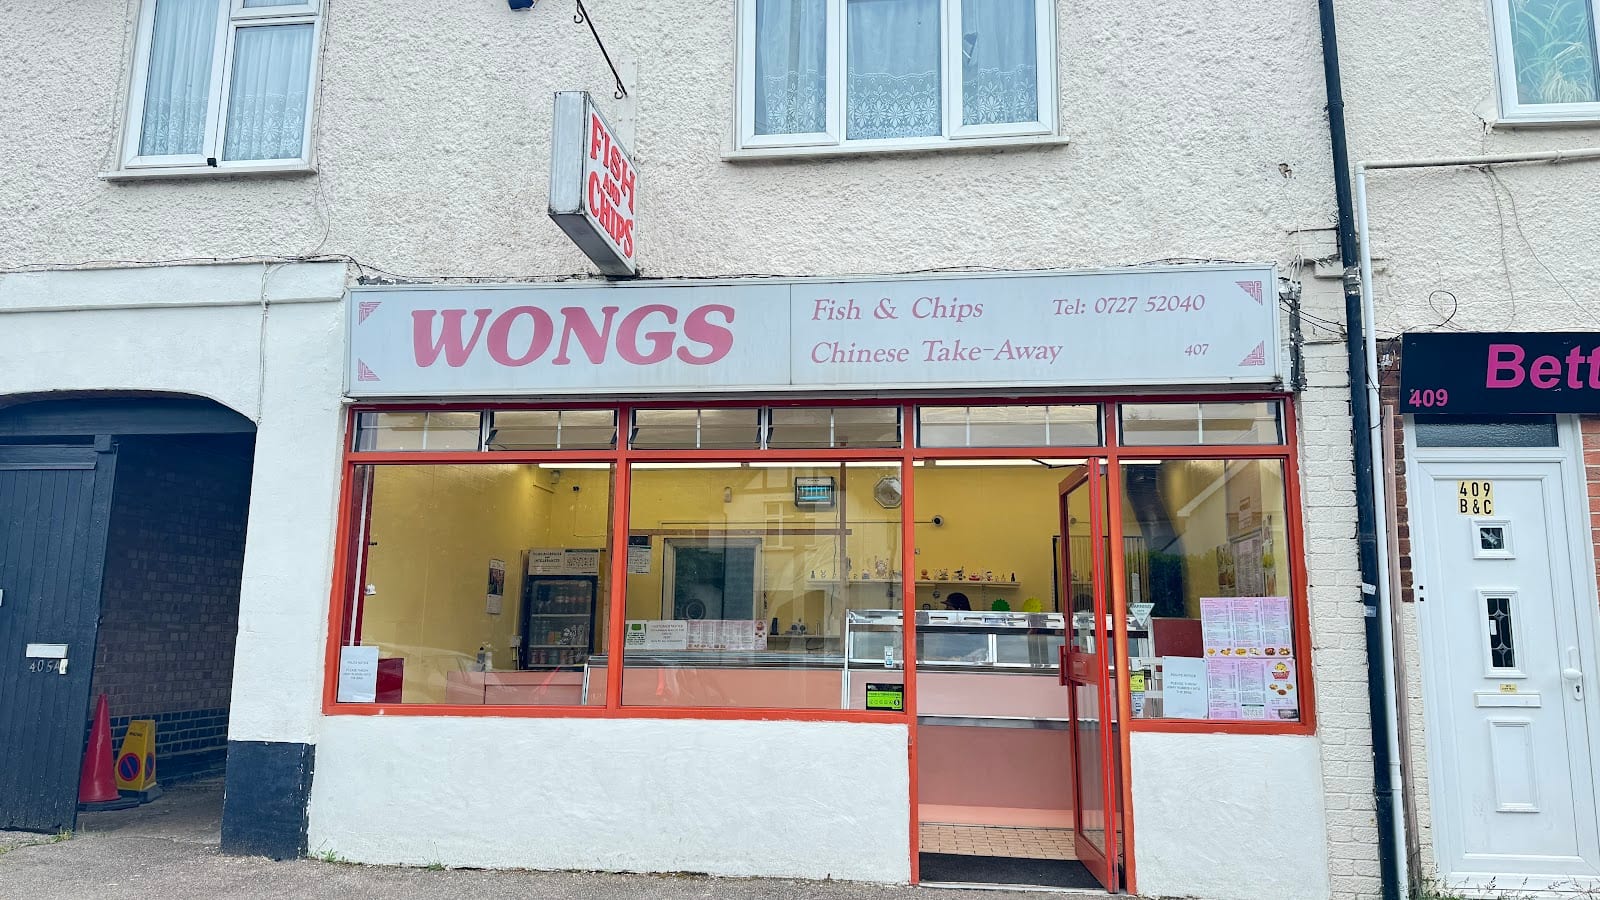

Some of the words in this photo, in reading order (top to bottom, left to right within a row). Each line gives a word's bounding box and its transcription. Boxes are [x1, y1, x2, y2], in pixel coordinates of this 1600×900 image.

[590, 113, 636, 215] FISH
[602, 173, 621, 207] AND
[588, 171, 634, 258] CHIPS
[811, 298, 862, 321] Fish
[873, 298, 899, 320] &
[911, 297, 984, 324] Chips
[1052, 298, 1086, 316] Tel:
[1094, 296, 1136, 314] 0727
[1143, 294, 1206, 313] 52040
[411, 303, 735, 368] WONGS
[810, 341, 910, 364] Chinese
[922, 339, 1064, 364] Take-Away
[1184, 343, 1209, 357] 407
[1408, 388, 1449, 408] 409
[1459, 481, 1491, 497] 409
